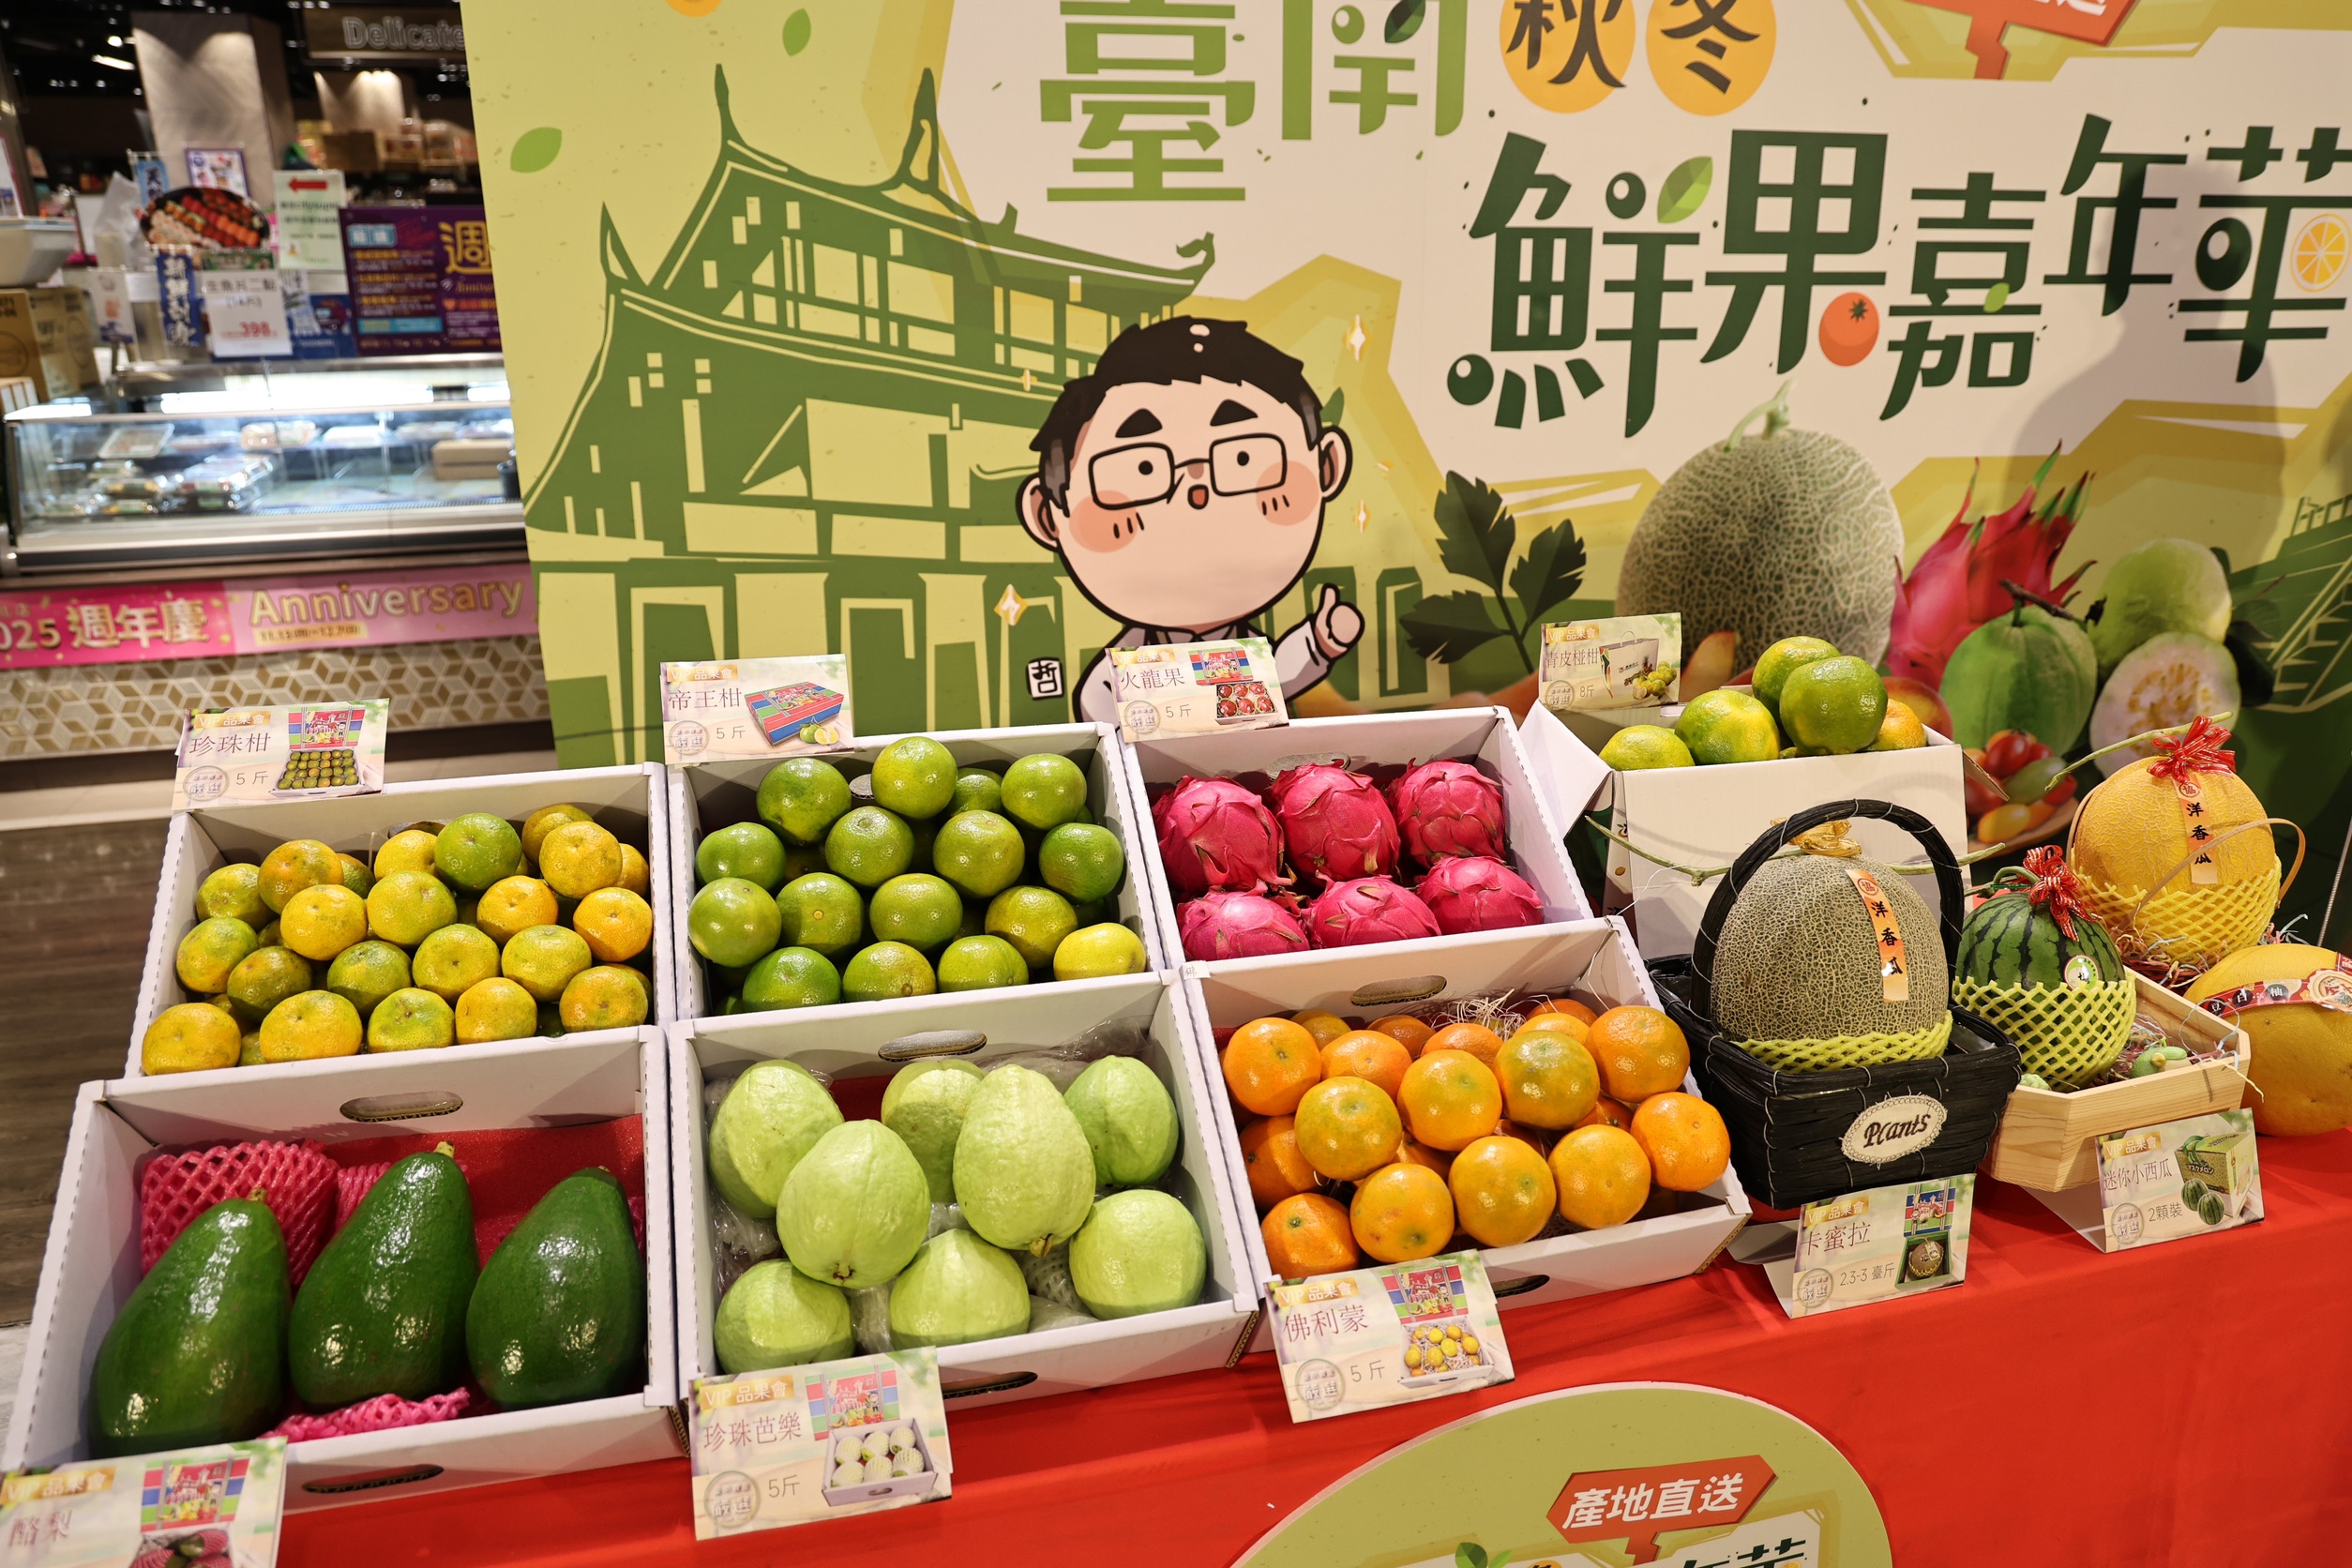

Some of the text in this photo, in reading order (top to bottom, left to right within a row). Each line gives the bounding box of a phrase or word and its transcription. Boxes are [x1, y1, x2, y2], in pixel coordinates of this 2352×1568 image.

[342, 16, 466, 51] Delicate
[1448, 113, 2352, 438] 鮮果嘉年華
[239, 322, 272, 338] 398
[249, 580, 524, 626] Anniversary
[66, 597, 210, 649] 週年慶
[1548, 630, 1564, 641] VIP
[1546, 648, 1600, 669] 青皮椪柑
[671, 670, 691, 680] VIP
[1120, 668, 1185, 691] 火龍果
[668, 687, 742, 711] 帝王柑
[1579, 684, 1595, 698] 8斤
[199, 716, 220, 727] VIP
[188, 732, 271, 757] 珍珠柑
[1871, 900, 1903, 975] 洋香瓜
[1862, 1112, 1932, 1148] Plants
[2105, 1136, 2158, 1156] VIP 品果會
[2102, 1158, 2173, 1191] 迷你小西瓜
[1808, 1200, 1865, 1223] VIP 品果會
[2148, 1201, 2183, 1222] 2顆裝
[1800, 1221, 1871, 1257] 卡蜜拉
[1840, 1268, 1868, 1287] 2.3-3
[1280, 1281, 1352, 1304] VIP 品果會
[1283, 1304, 1368, 1343] 佛利蒙
[704, 1380, 788, 1406] VIP 品果會
[702, 1412, 802, 1452] 珍珠芭樂
[1562, 1473, 1745, 1530] 產地直送
